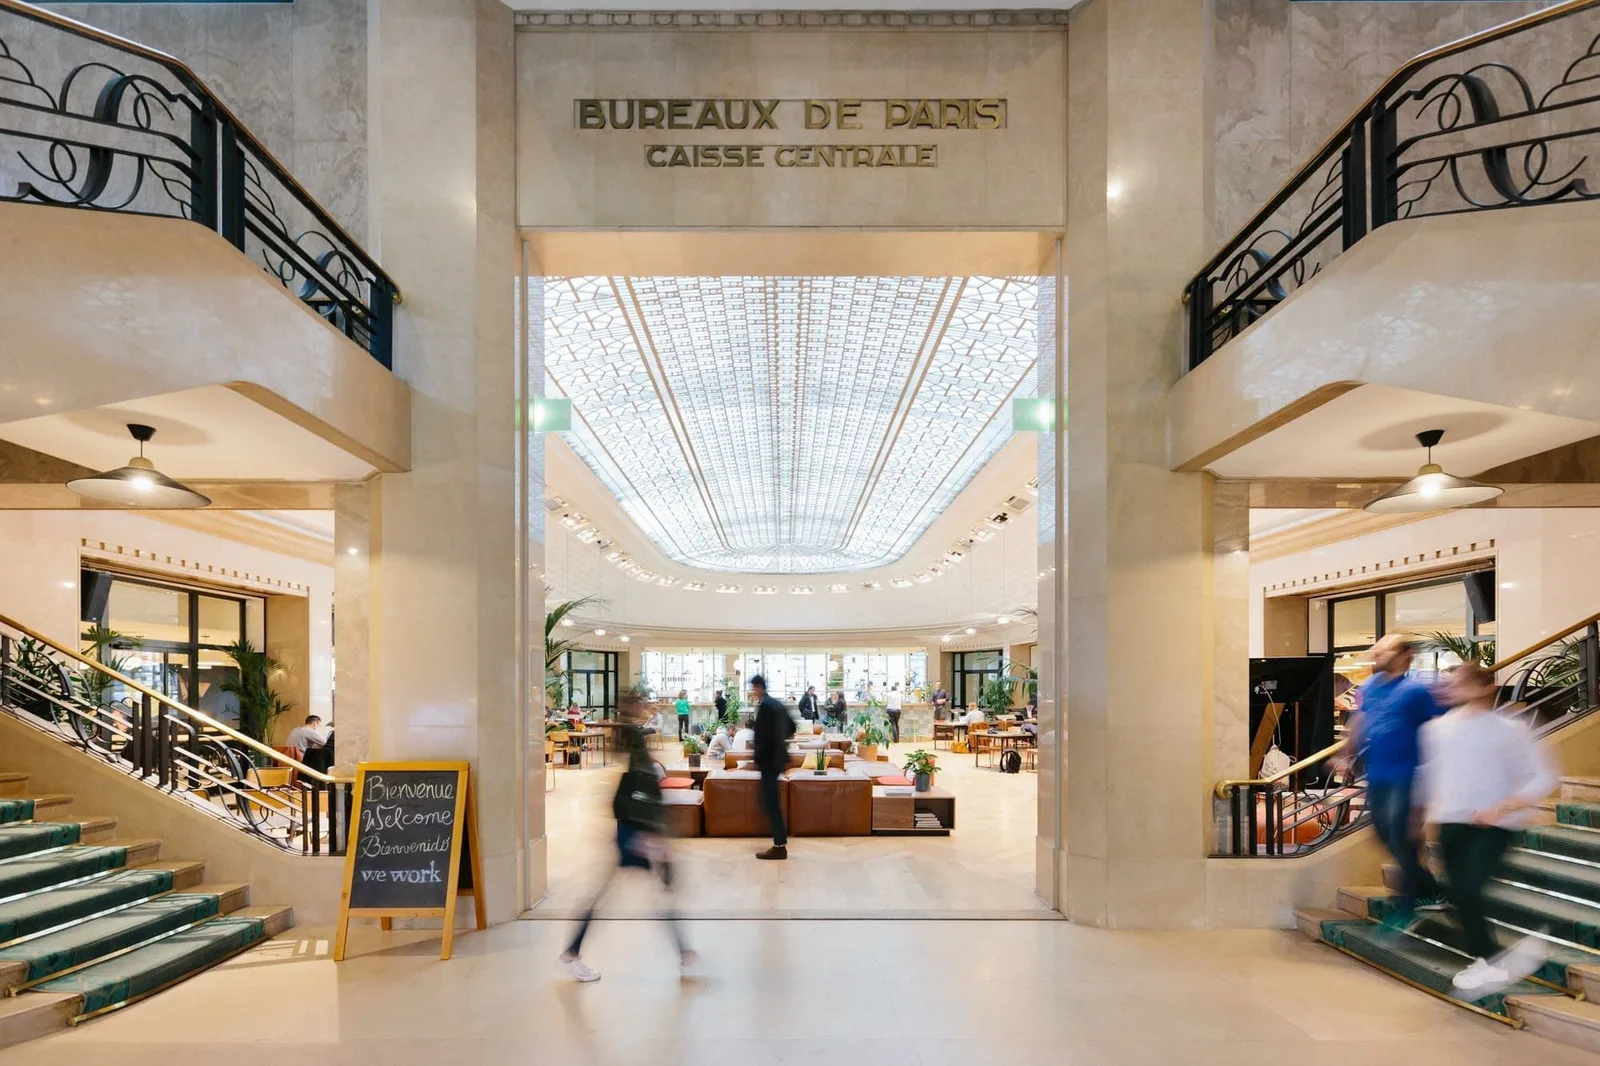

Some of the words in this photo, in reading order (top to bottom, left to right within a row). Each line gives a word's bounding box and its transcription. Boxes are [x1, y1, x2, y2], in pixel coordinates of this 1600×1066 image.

[579, 99, 780, 129] BUREAUX
[804, 99, 863, 129] DE
[885, 99, 1001, 129] PARIS
[646, 146, 765, 167] CAISSE
[774, 146, 935, 167] CENTRALE
[366, 775, 455, 802] Bienvenue
[363, 804, 454, 832] Welcome
[358, 833, 450, 858] Bienvenido
[391, 860, 442, 883] work
